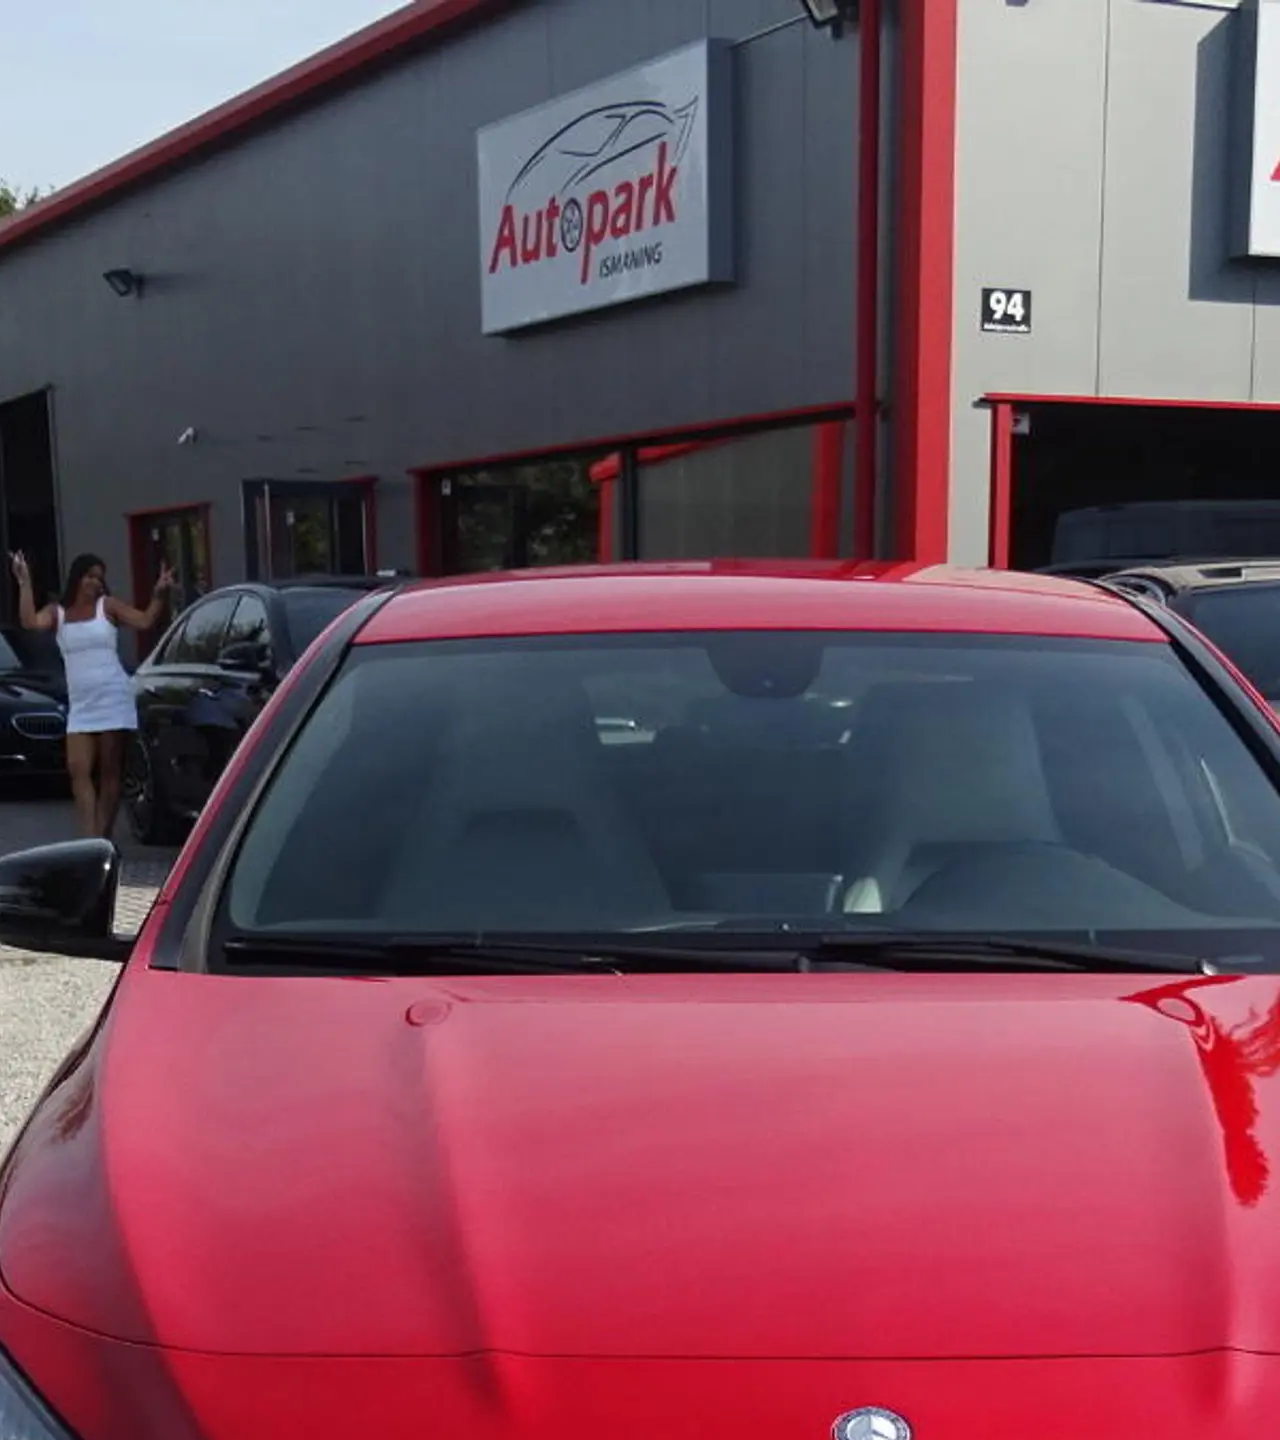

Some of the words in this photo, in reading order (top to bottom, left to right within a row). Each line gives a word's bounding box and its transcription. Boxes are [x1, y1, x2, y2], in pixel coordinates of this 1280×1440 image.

[488, 142, 678, 285] Autopark
[598, 242, 663, 281] ISMANING
[989, 290, 1025, 322] 94
